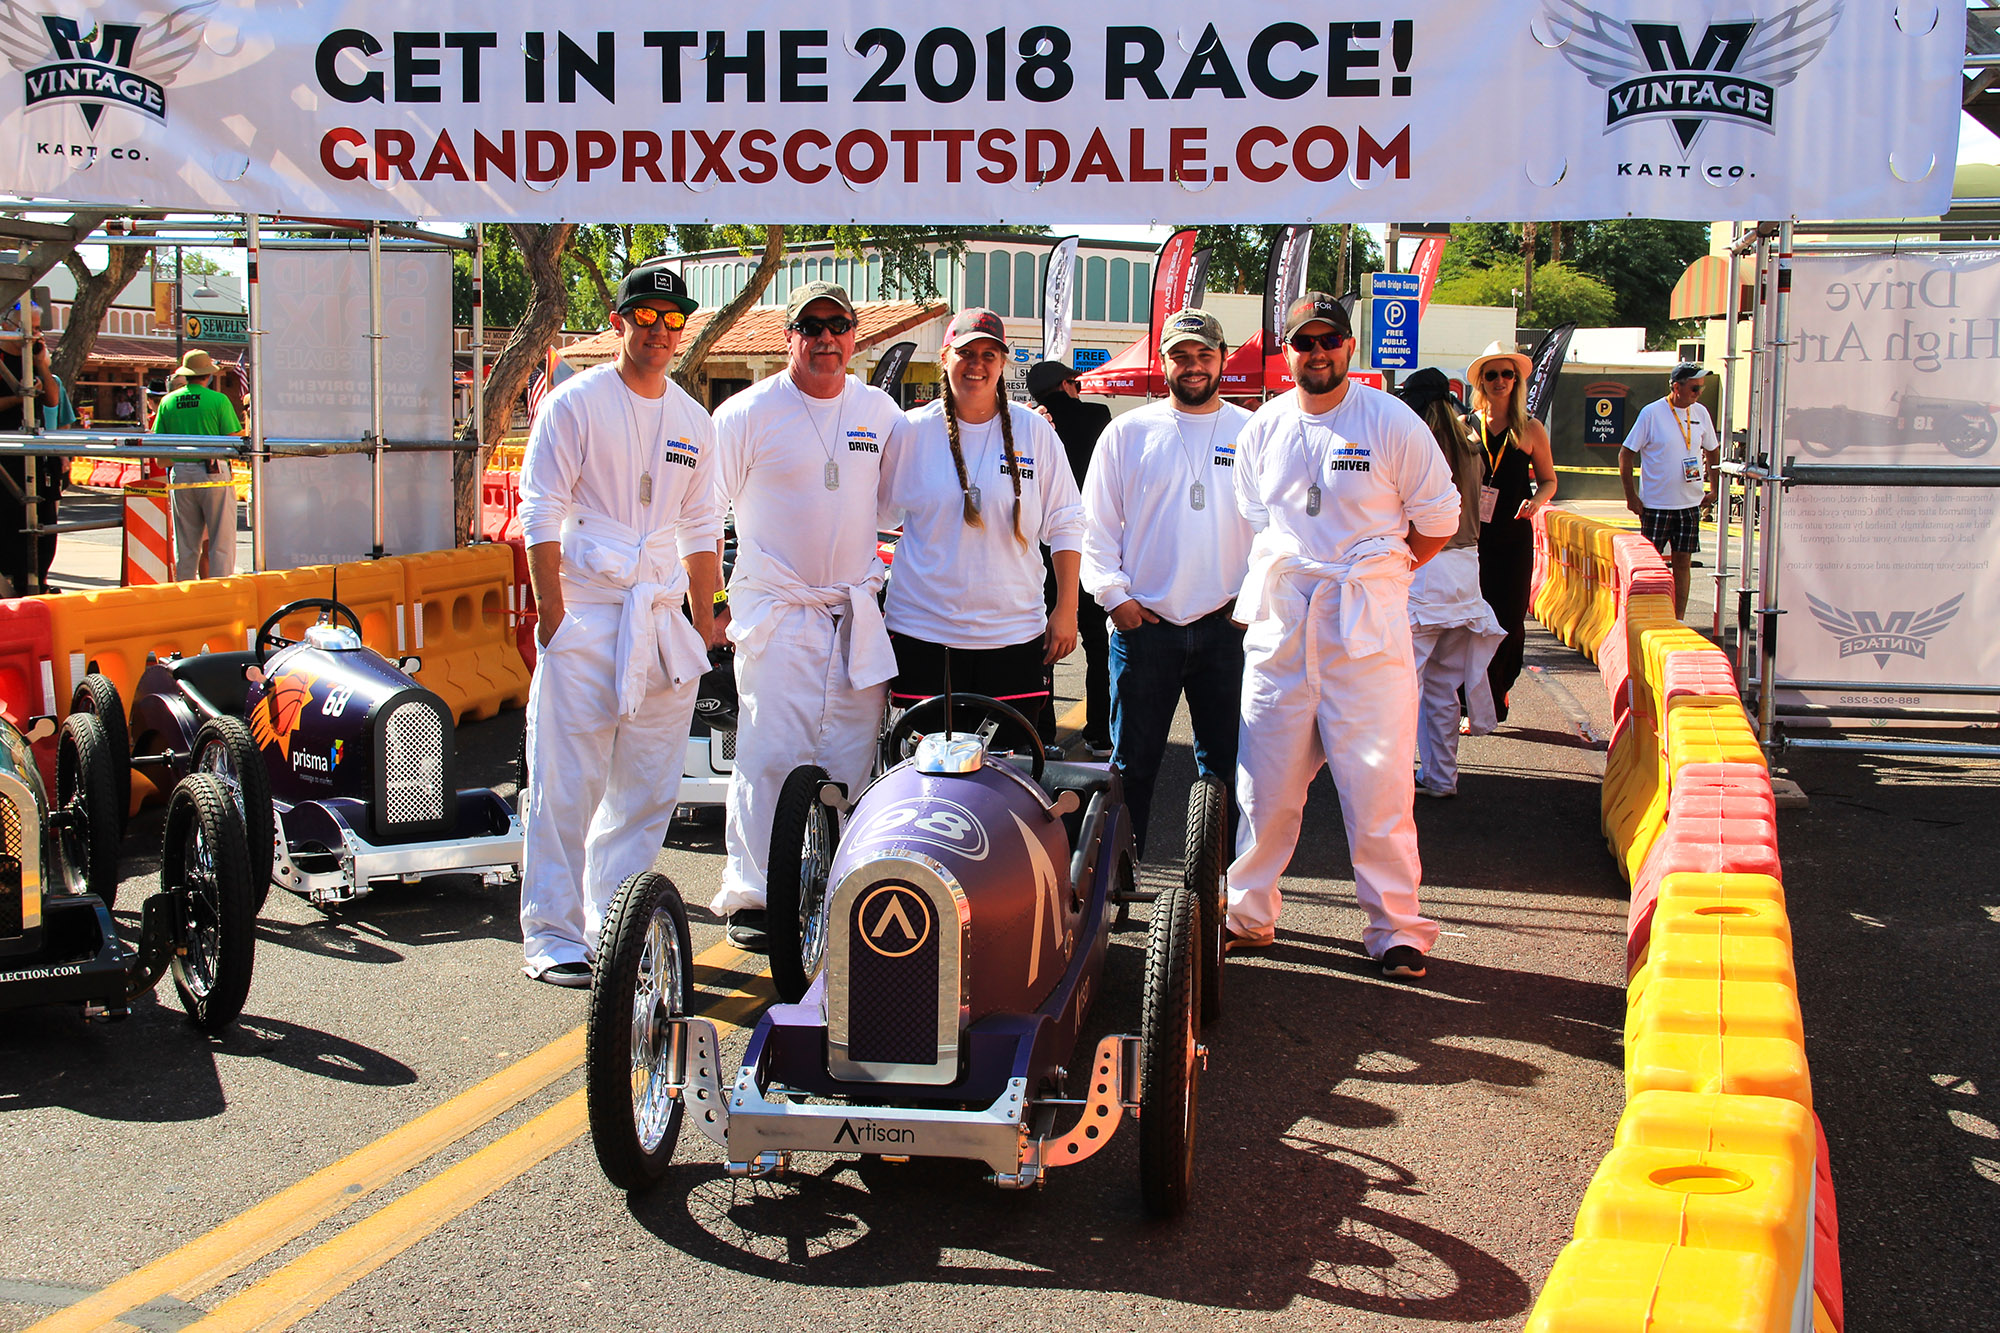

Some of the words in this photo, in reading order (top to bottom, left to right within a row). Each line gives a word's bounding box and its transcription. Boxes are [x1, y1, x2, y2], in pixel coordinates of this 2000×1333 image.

[314, 27, 498, 105] GET
[523, 30, 616, 105] IN
[643, 29, 829, 105] THE
[852, 24, 1075, 104] 2018
[1104, 19, 1415, 101] RACE!
[25, 67, 165, 112] VINTAGE
[1610, 79, 1770, 118] VINTAGE
[36, 142, 98, 161] KART
[110, 146, 150, 162] CO.
[319, 122, 1413, 185] GRANDPRIXSCOTTSDALE.COM
[1616, 161, 1692, 178] KART
[1707, 164, 1756, 178] CO.
[1167, 238, 1183, 284] STEELE
[1274, 277, 1283, 303] AND
[1373, 279, 1387, 289] South
[1387, 279, 1402, 291] Bridge
[1402, 280, 1418, 292] Garage
[1053, 292, 1061, 315] AND
[1164, 286, 1172, 310] AND
[1390, 305, 1402, 323] P
[1381, 338, 1408, 346] PUBLIC
[1385, 329, 1404, 337] FREE
[1076, 351, 1105, 361] FREE
[1378, 346, 1411, 355] PARKING
[176, 394, 201, 402] TRACK
[176, 400, 199, 409] CREW
[1526, 384, 1538, 411] AND
[1591, 425, 1615, 434] Parking
[1594, 418, 1613, 426] Public
[666, 439, 687, 450] GRAND
[687, 444, 700, 455] PRIX
[848, 441, 880, 454] DRIVER
[1332, 448, 1353, 456] GRAND
[1354, 449, 1371, 457] PRIX
[665, 451, 697, 470] DRIVER
[1020, 456, 1035, 465] PRIX
[1331, 460, 1370, 472] DRIVER
[321, 684, 355, 718] 68
[293, 747, 329, 773] prisma
[861, 807, 973, 841] 98
[832, 1117, 916, 1146] Artisan
